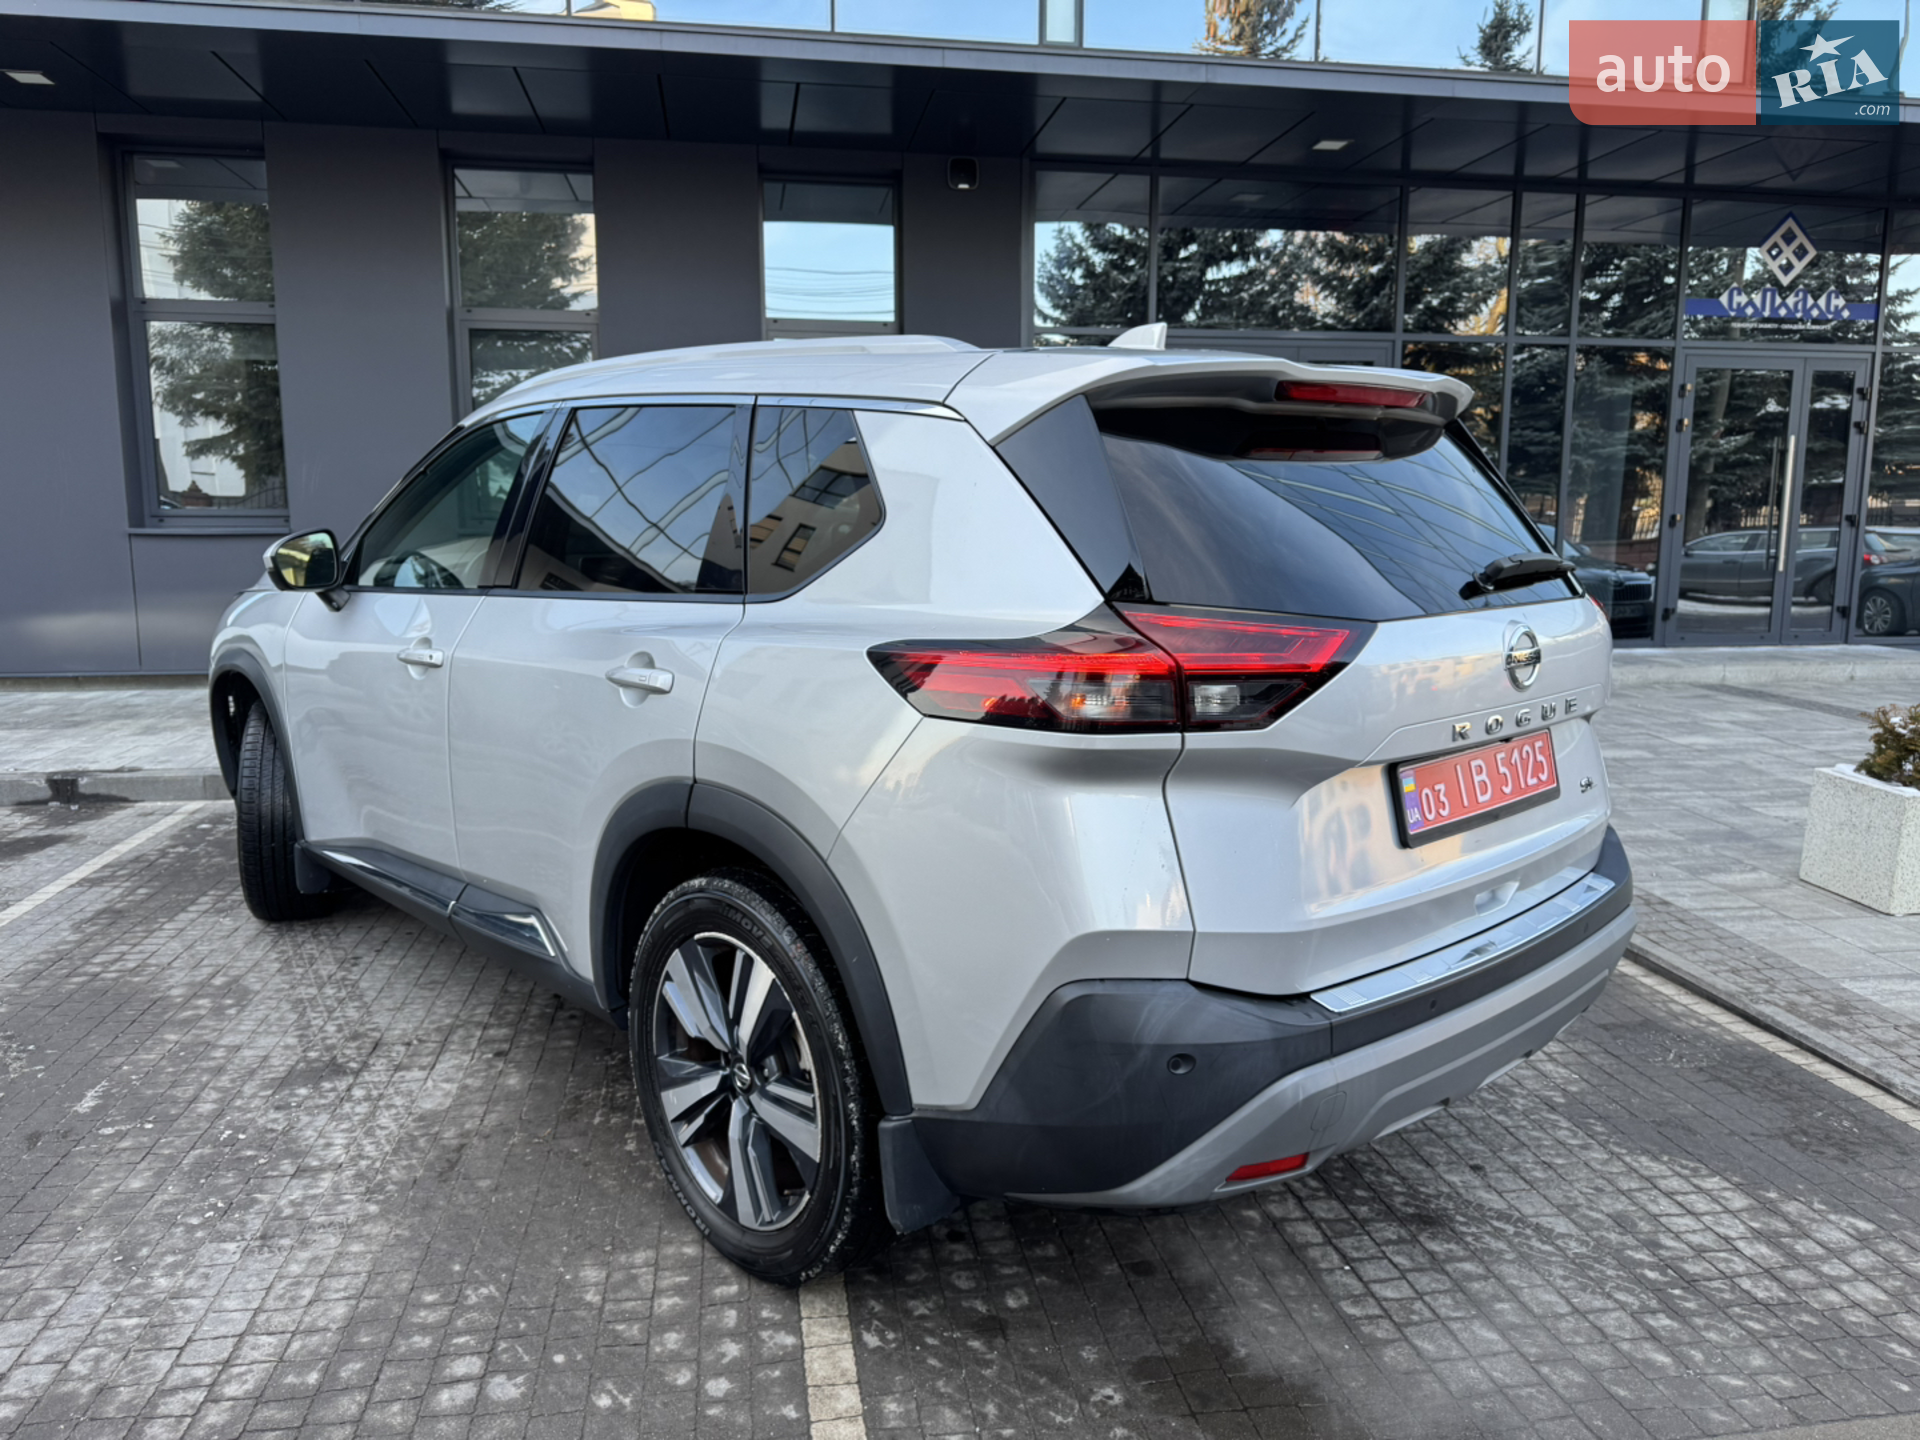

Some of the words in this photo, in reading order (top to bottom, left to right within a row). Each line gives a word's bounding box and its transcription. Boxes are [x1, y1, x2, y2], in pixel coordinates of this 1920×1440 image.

[1452, 697, 1578, 742] ROGUE
[1421, 783, 1450, 821] 03
[1455, 758, 1493, 808] IB
[1495, 740, 1549, 796] 5125
[1407, 806, 1422, 823] UA
